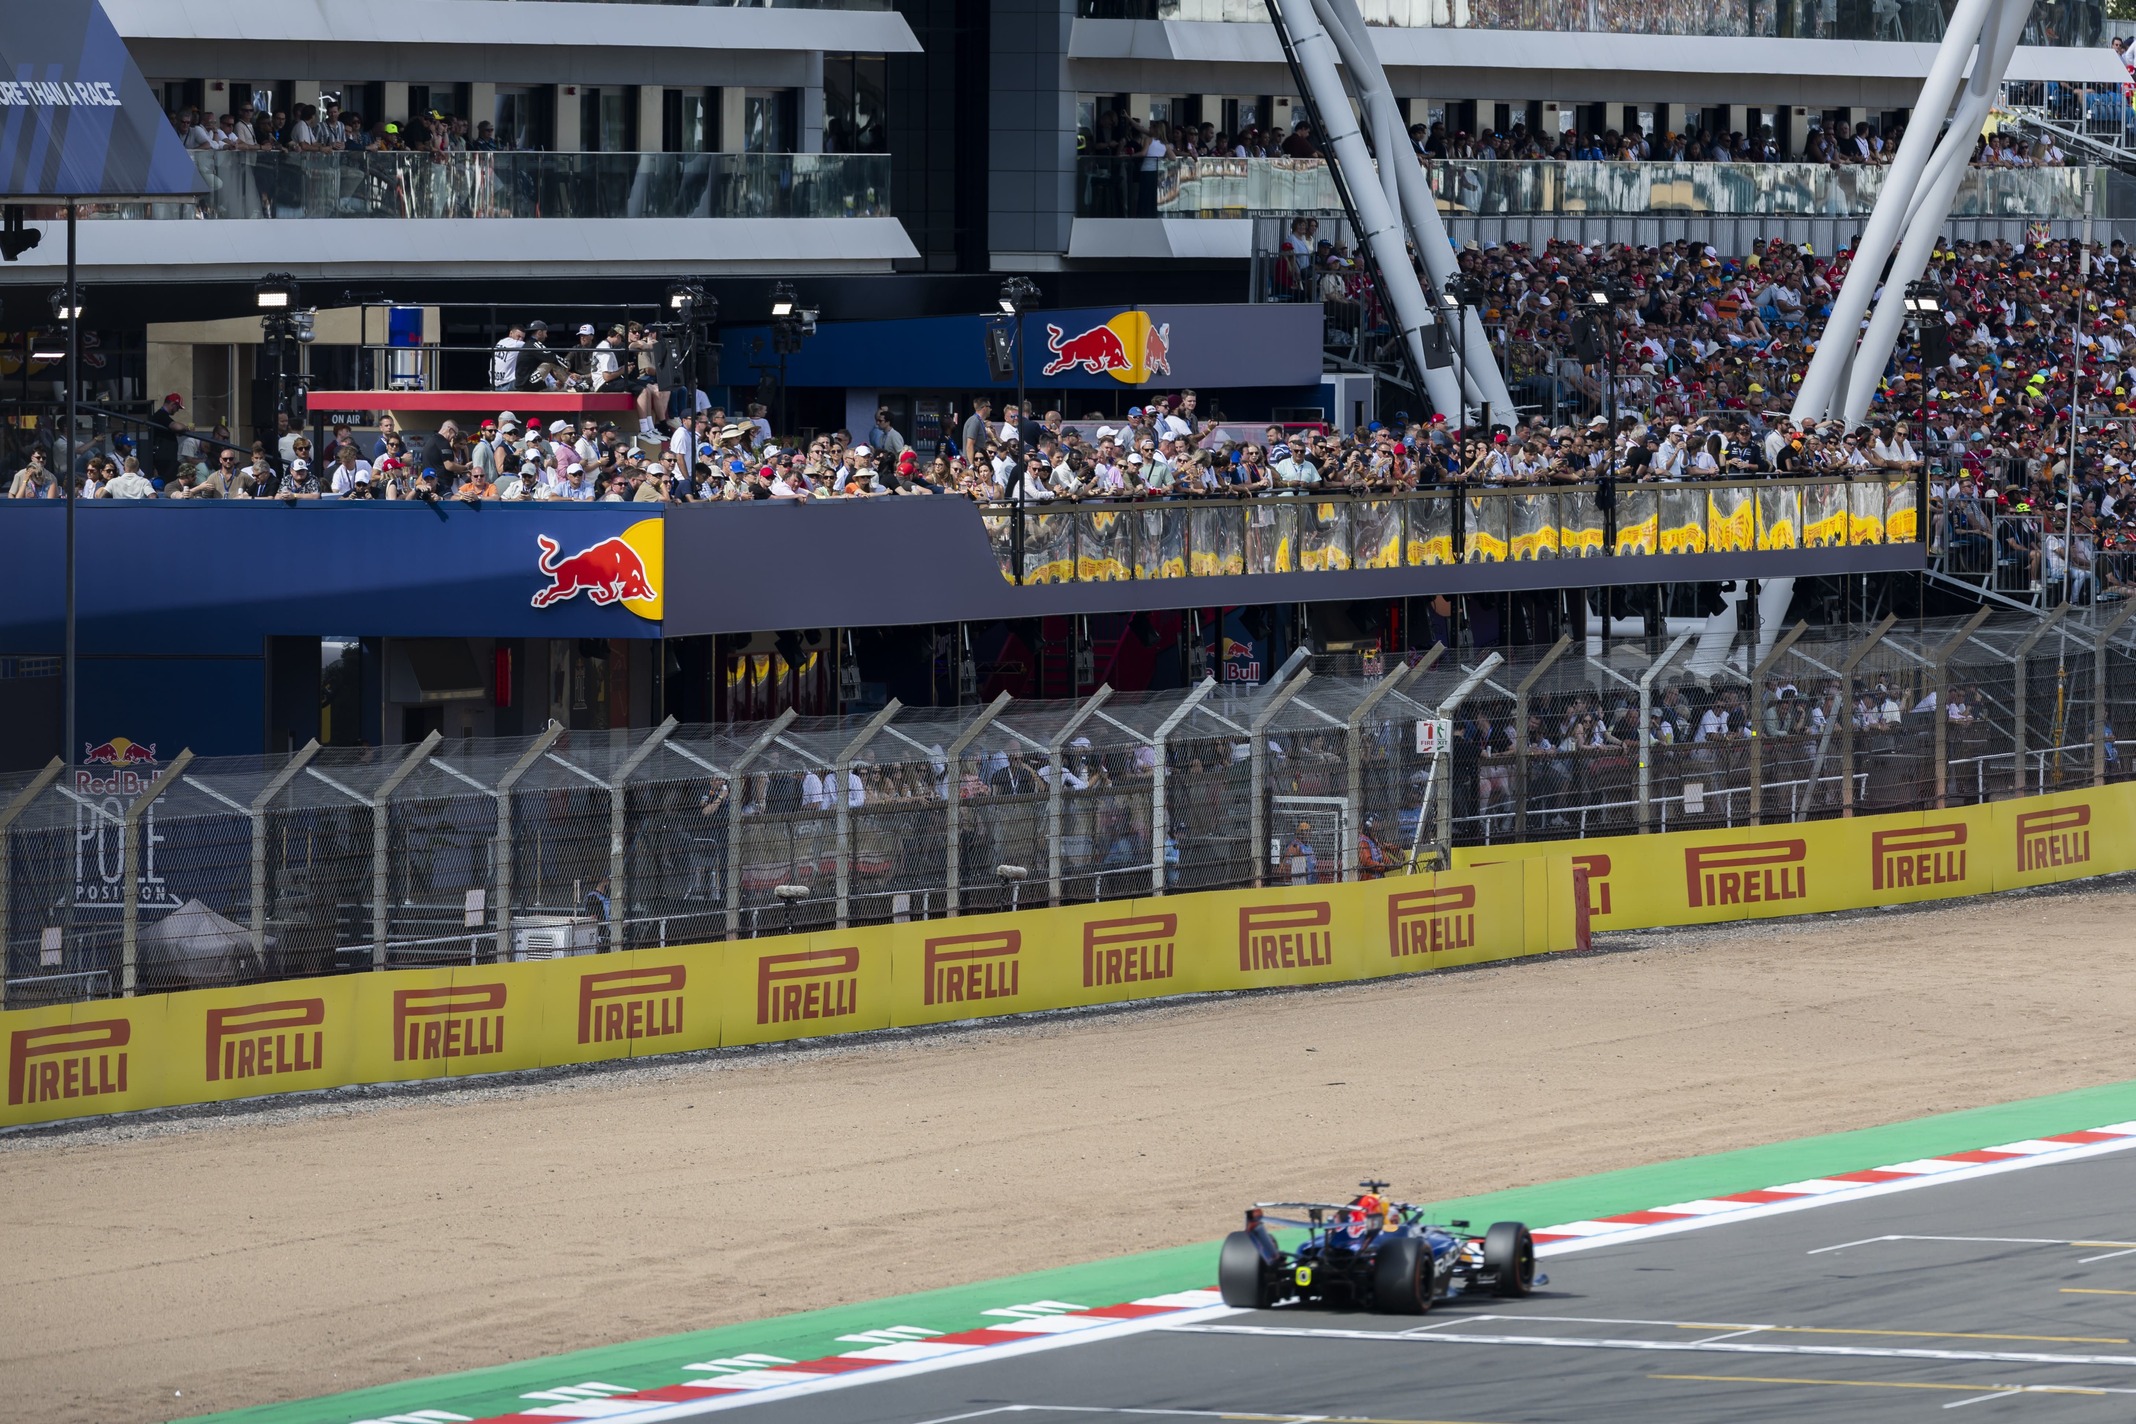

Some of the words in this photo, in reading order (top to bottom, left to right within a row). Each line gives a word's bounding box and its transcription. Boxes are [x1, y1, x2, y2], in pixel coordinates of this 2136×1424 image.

[0, 81, 30, 106] ORE
[20, 81, 70, 106] THAN
[63, 81, 83, 106] A
[74, 81, 122, 106] RACE
[331, 414, 345, 425] ON
[346, 414, 361, 425] AIR
[1227, 662, 1260, 681] Bull
[75, 770, 121, 795] Red
[1685, 839, 1806, 907] PIRELLI
[1872, 824, 1967, 889] PIRELLI
[2016, 806, 2090, 871] PIRELLI
[1084, 914, 1176, 986] PIRELLI
[1240, 902, 1330, 970] PIRELLI
[1389, 885, 1475, 957] PIRELLI
[758, 948, 859, 1024] PIRELLI
[925, 931, 1020, 1004] PIRELLI
[394, 984, 506, 1061] PIRELLI
[579, 965, 685, 1043] PIRELLI
[9, 1019, 131, 1106] PIRELLI
[206, 999, 324, 1081] PIRELLI
